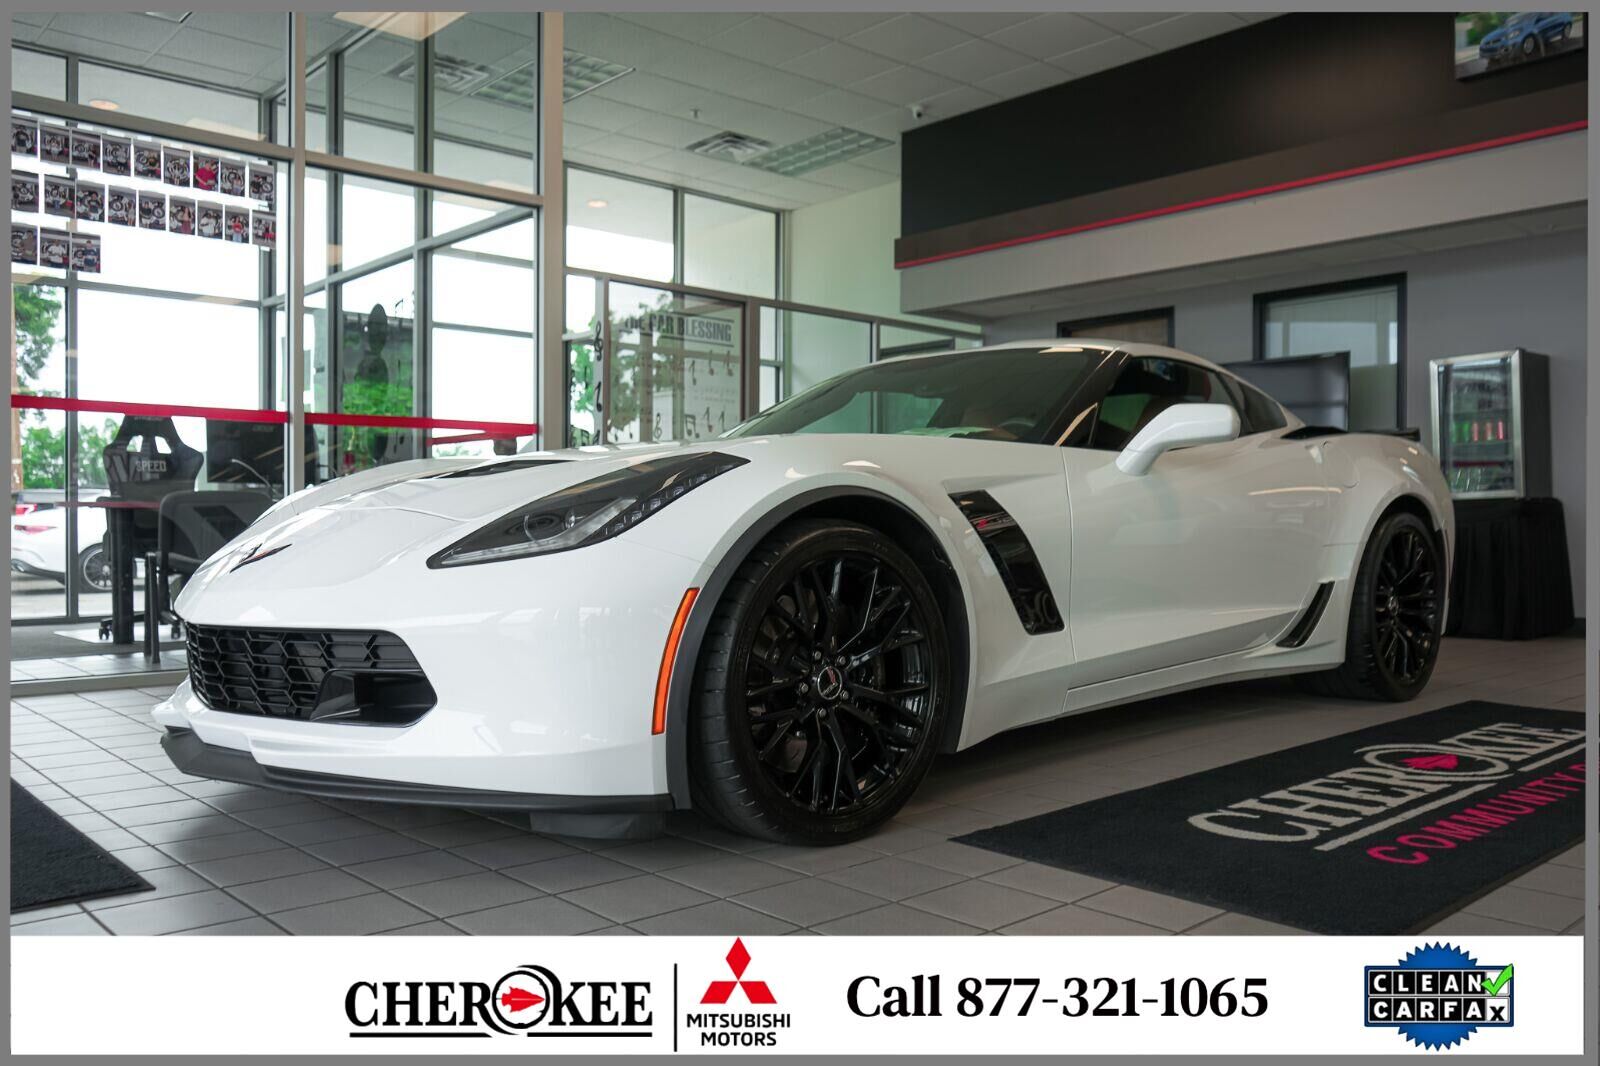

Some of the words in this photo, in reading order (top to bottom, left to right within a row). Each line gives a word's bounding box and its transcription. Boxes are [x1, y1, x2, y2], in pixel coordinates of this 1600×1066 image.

[649, 313, 674, 335] CAR
[676, 317, 732, 342] BLESSING
[135, 460, 167, 472] SPEED
[1187, 722, 1586, 842] CHEROKEE
[1366, 771, 1586, 865] COMMUNITY
